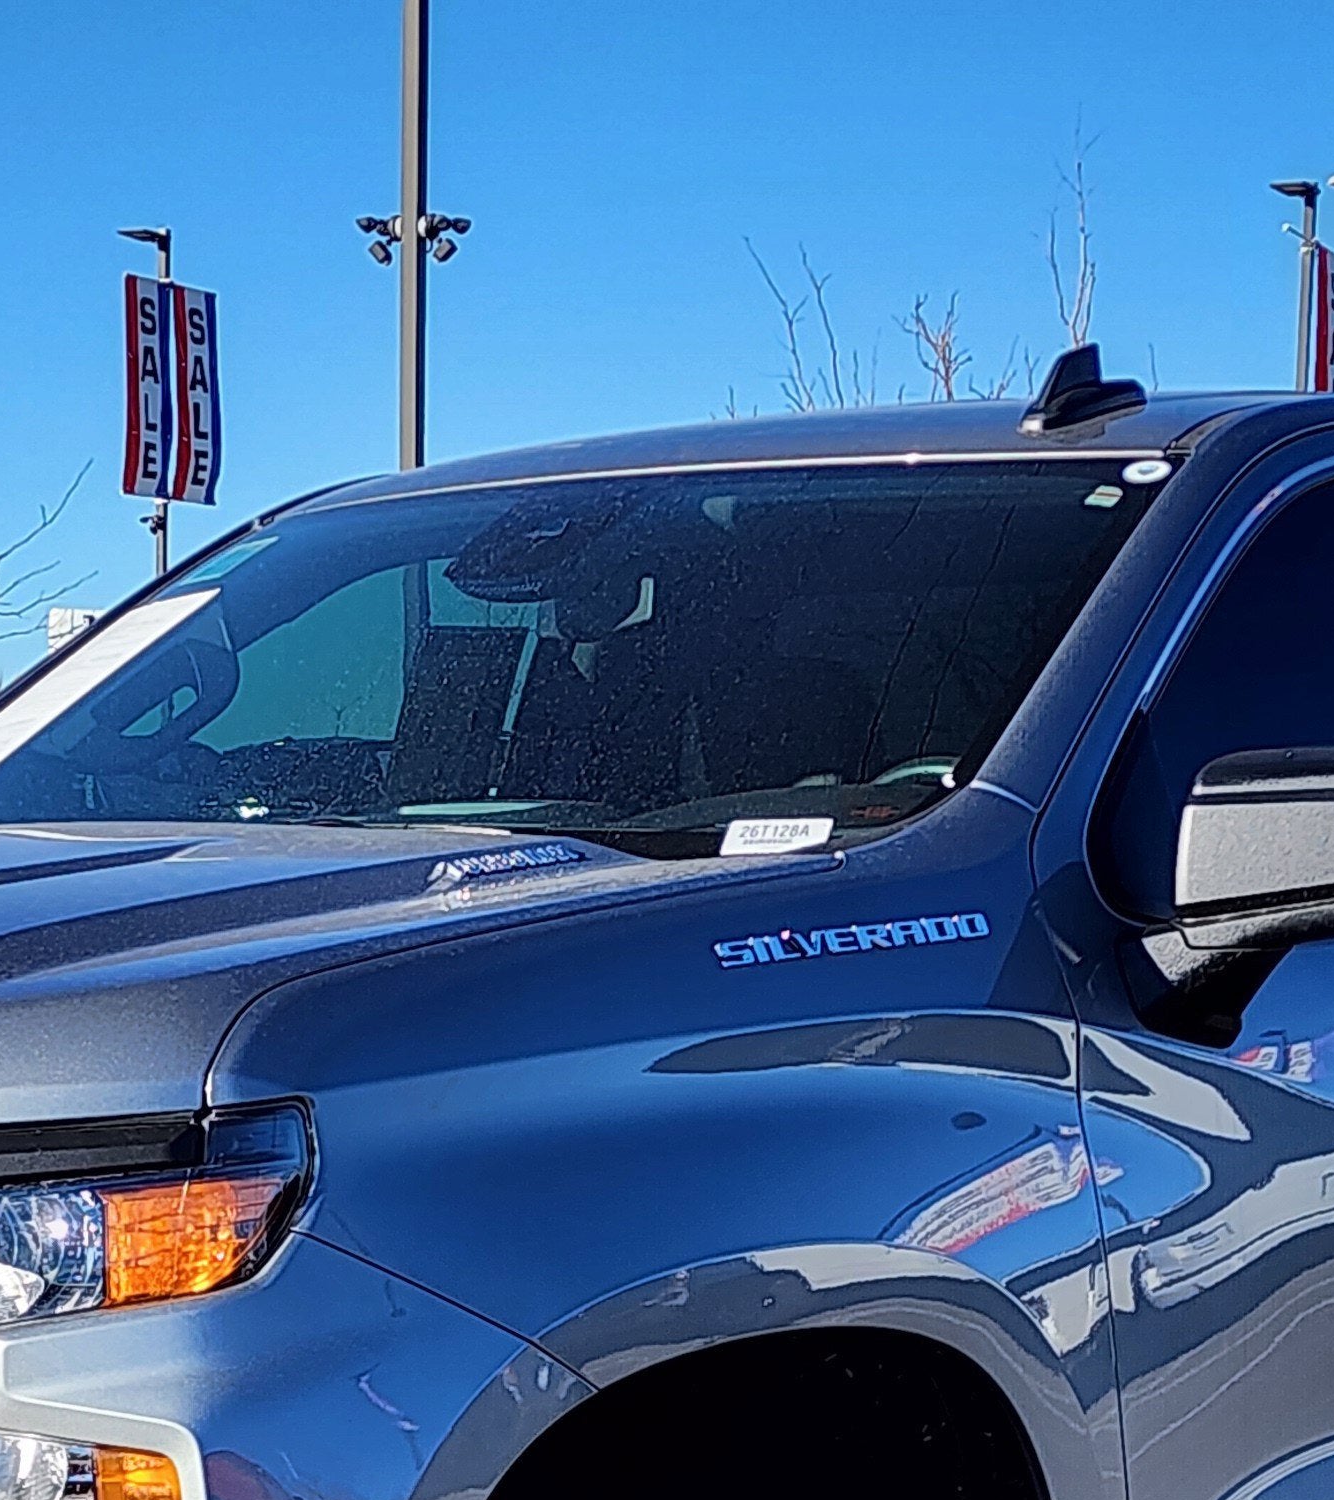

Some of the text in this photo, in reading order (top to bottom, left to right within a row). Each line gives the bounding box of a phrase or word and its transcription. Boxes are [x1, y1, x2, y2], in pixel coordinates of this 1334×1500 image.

[139, 296, 160, 479] SALE
[188, 307, 209, 486] SALE
[739, 824, 810, 838] 26T128A
[715, 913, 989, 967] SILVERADO
